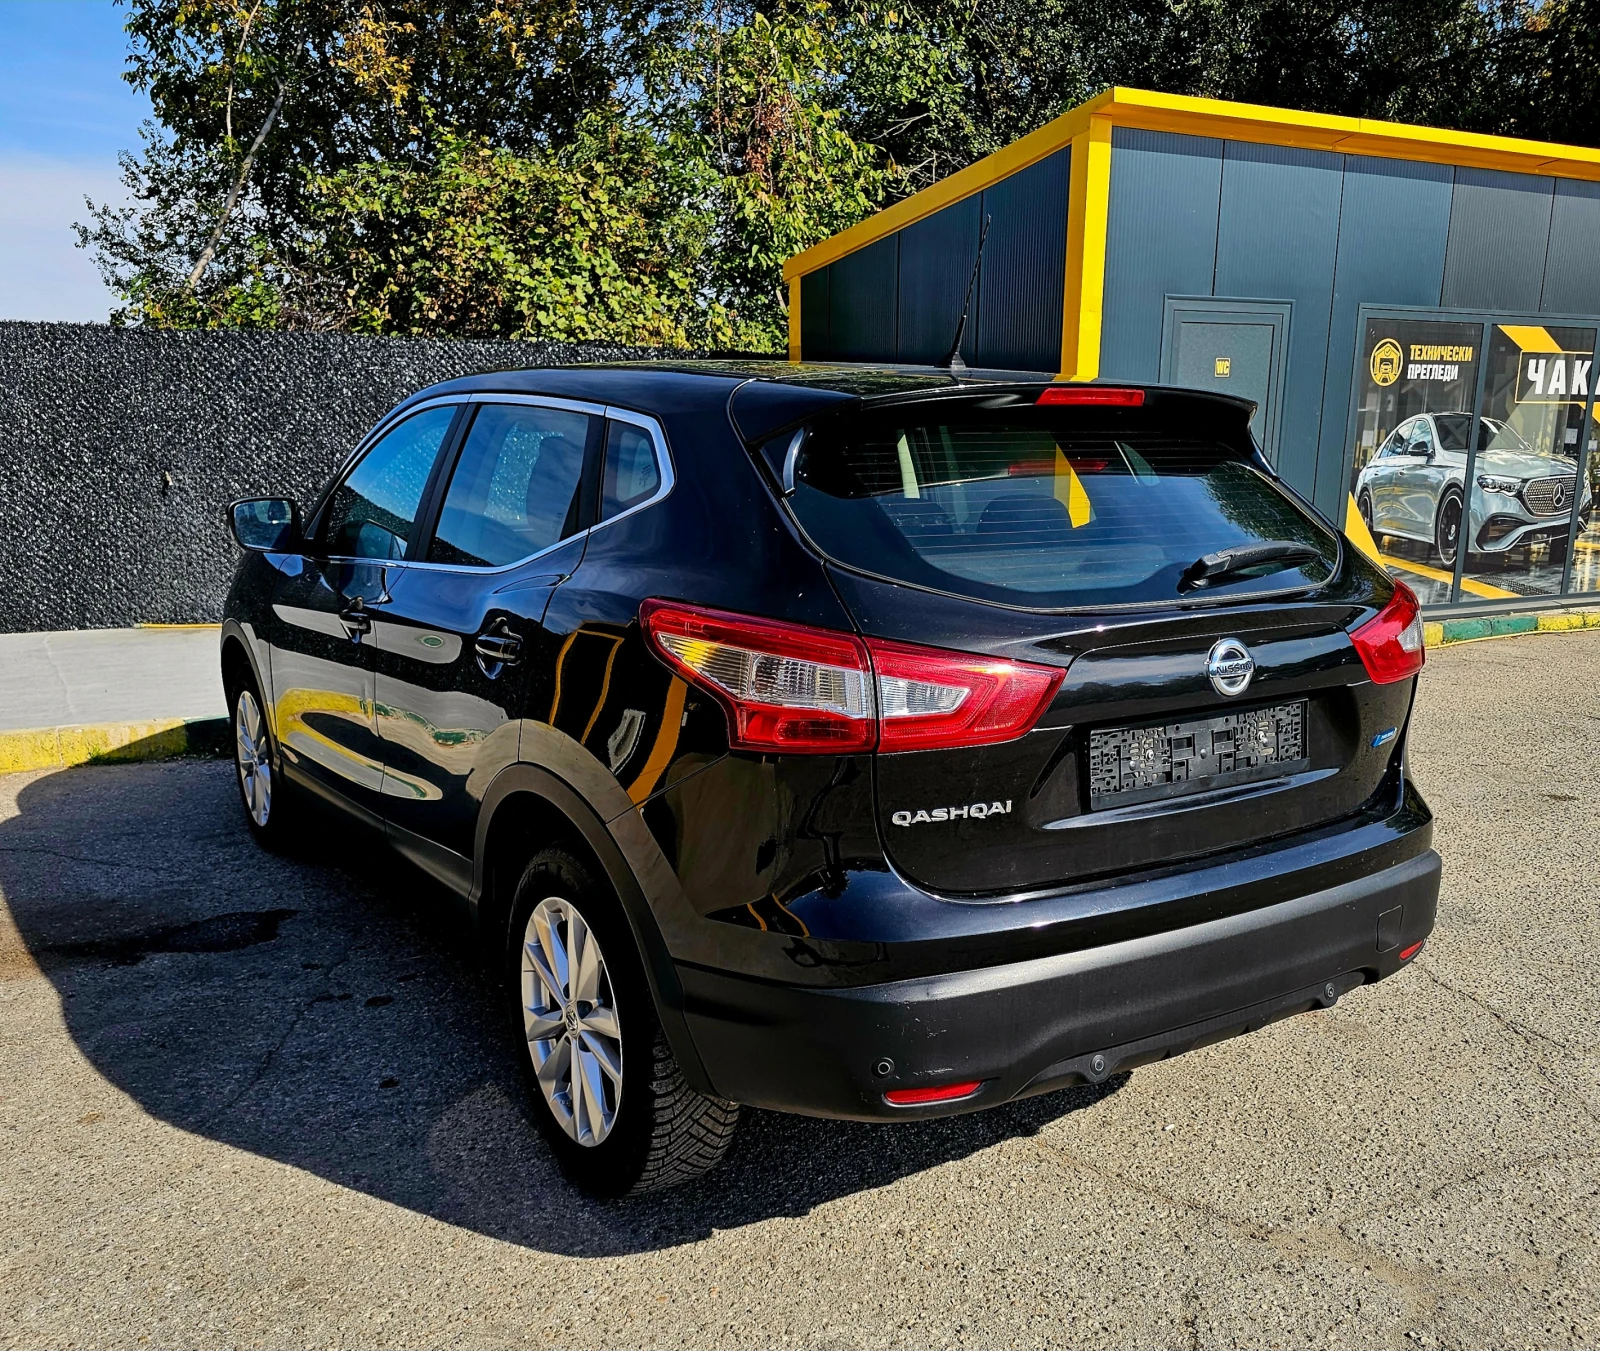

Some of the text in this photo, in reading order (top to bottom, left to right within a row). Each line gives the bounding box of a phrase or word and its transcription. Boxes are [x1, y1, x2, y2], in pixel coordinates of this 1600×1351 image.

[1410, 345, 1473, 361] ТЕХНИЧЕСКИ
[1216, 360, 1229, 374] WC
[1407, 364, 1459, 382] ПРЕГЛЕДИ
[1527, 359, 1600, 395] ЧАК
[1216, 661, 1252, 674] NISSAN
[892, 800, 1013, 827] QASHQAI
